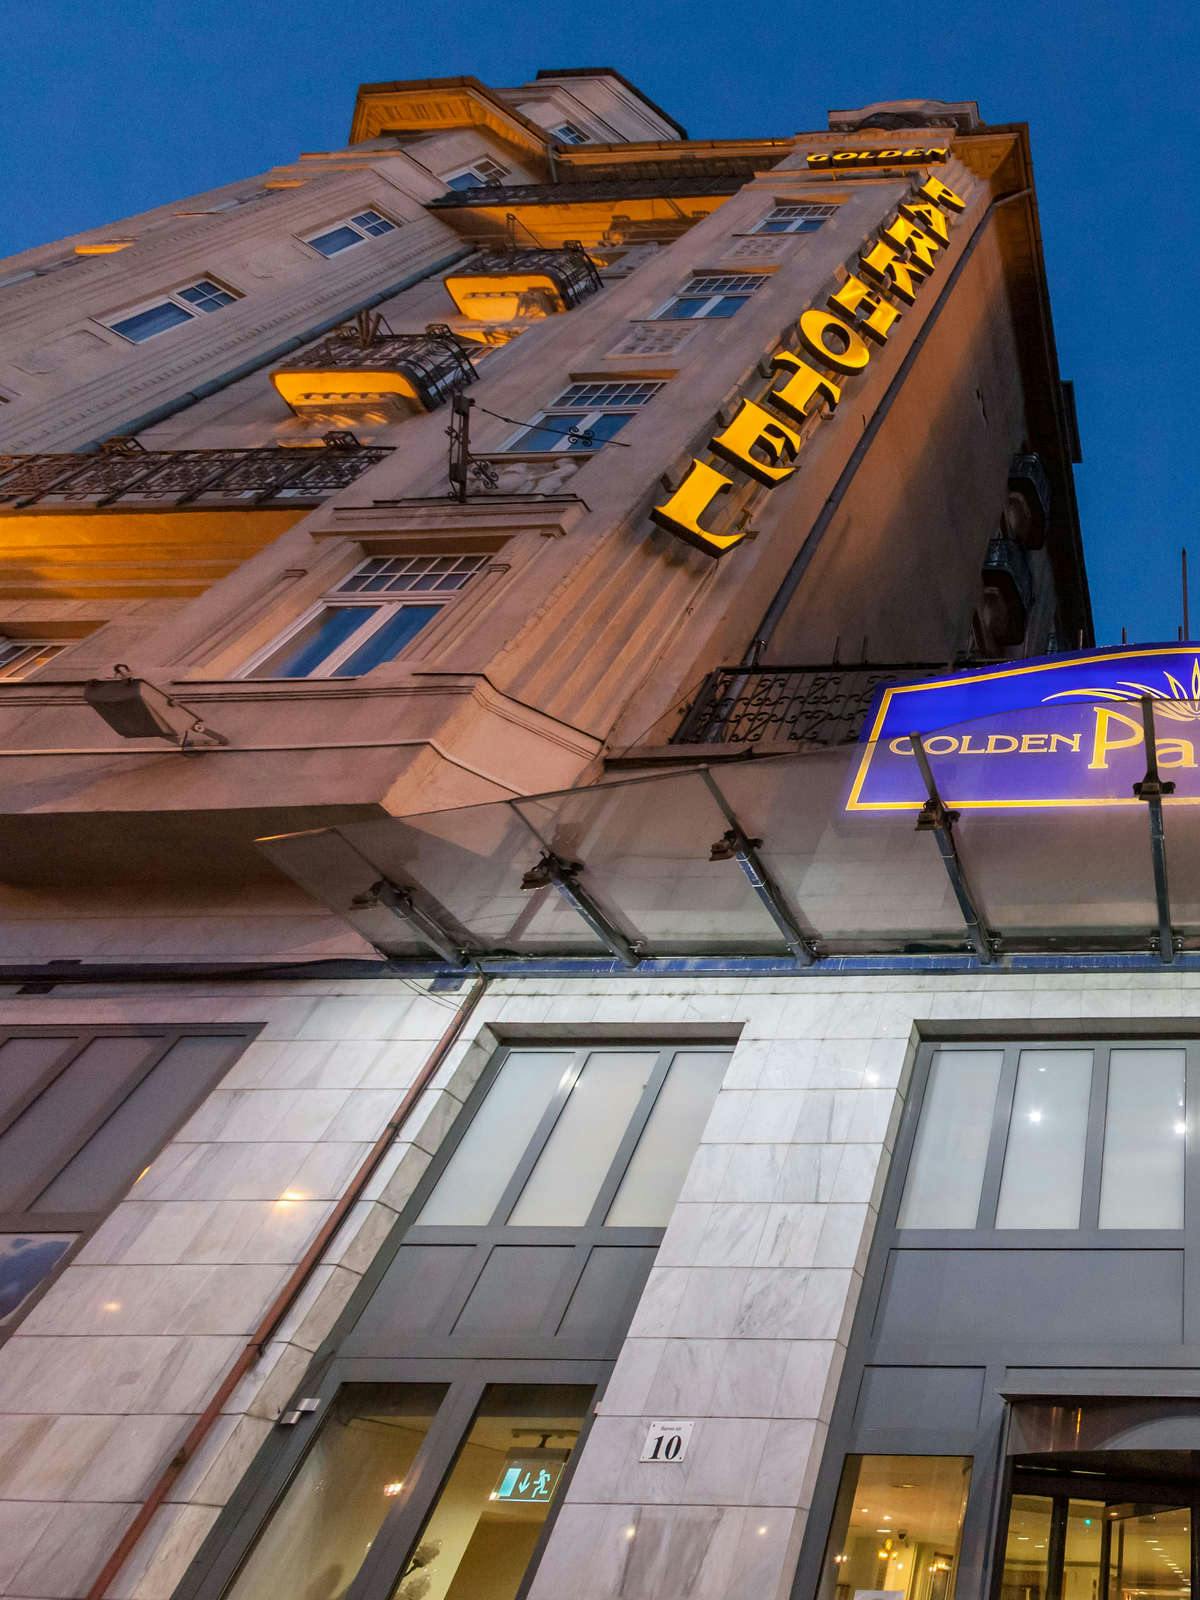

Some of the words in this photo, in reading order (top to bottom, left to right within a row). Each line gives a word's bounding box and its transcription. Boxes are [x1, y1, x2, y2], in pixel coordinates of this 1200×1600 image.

[806, 147, 949, 165] GOLDEN
[861, 175, 967, 304] PARK
[650, 273, 903, 556] HOTEL
[889, 733, 1082, 755] GOLDEN
